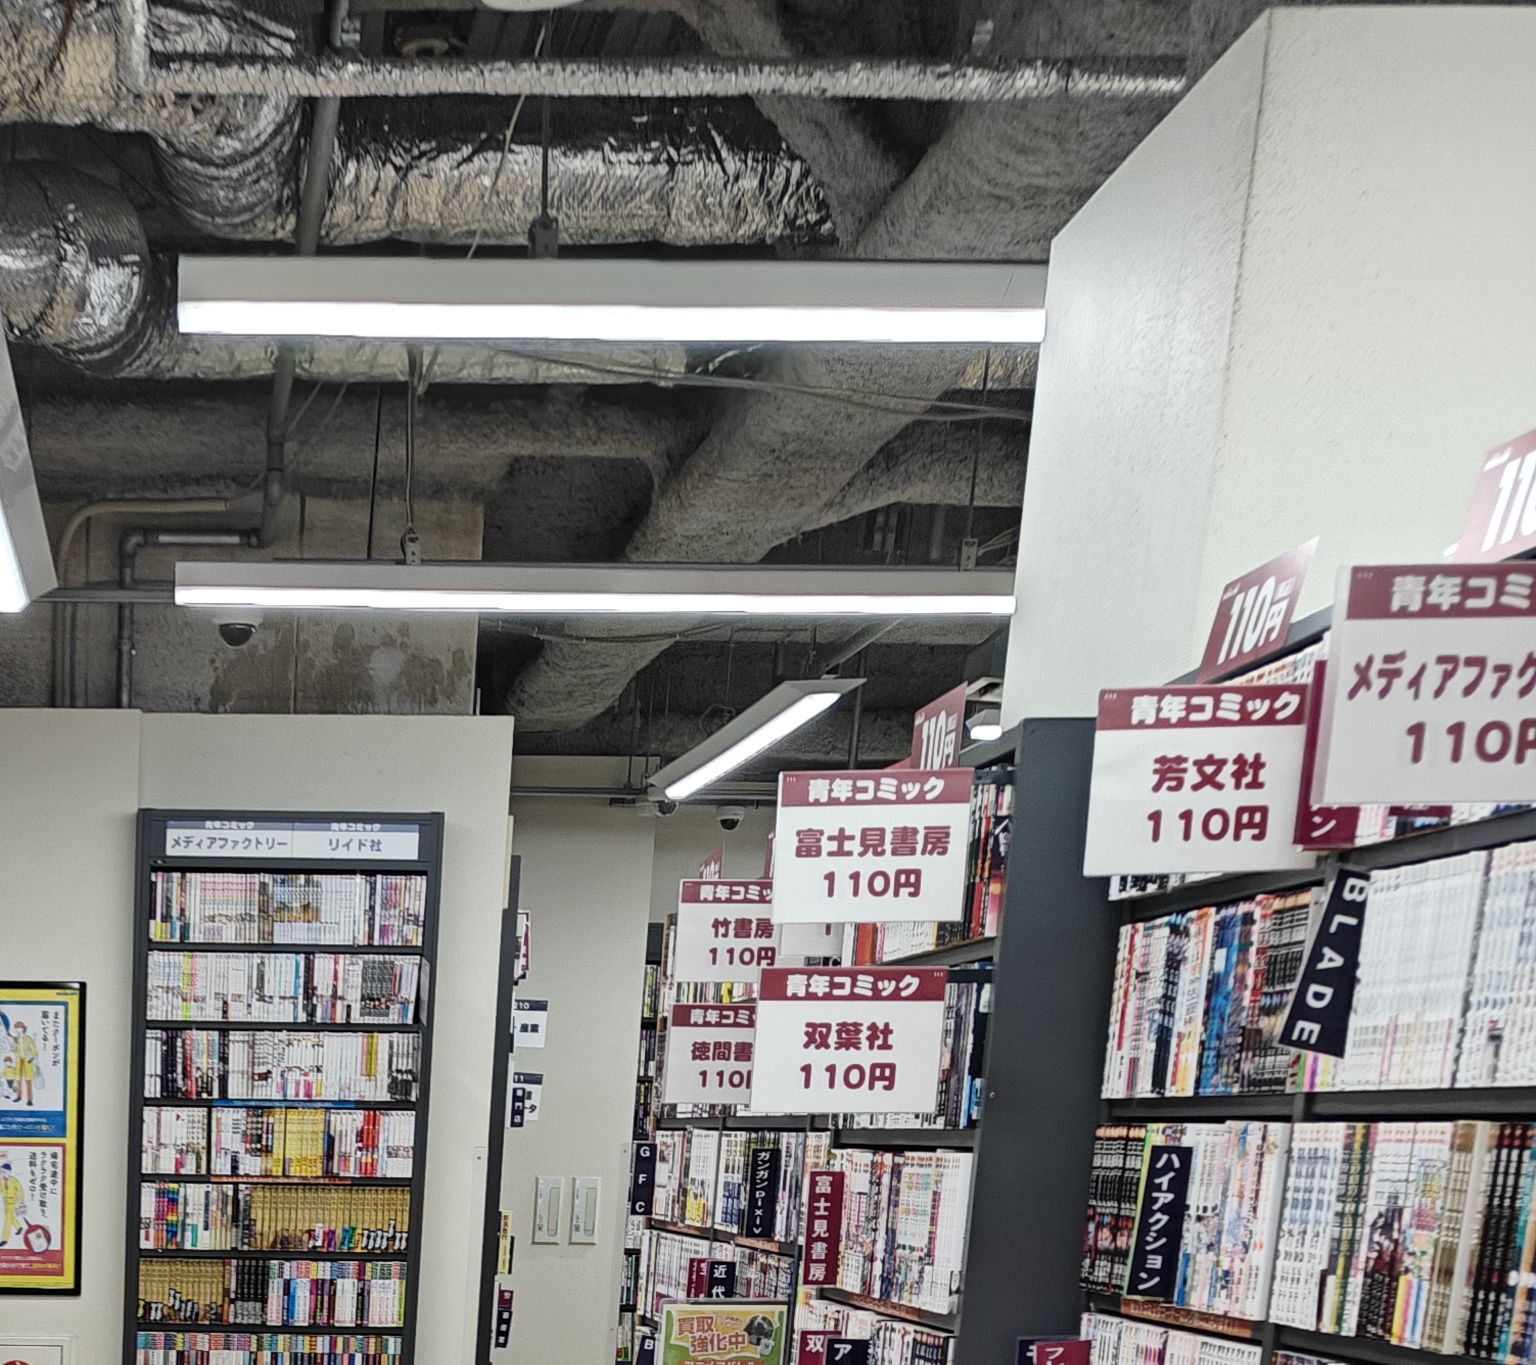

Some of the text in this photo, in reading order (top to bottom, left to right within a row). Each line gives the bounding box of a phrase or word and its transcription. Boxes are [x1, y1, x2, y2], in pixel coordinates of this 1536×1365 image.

[1130, 691, 1302, 726] 青年コミック
[1152, 753, 1266, 793] 芳文社
[808, 778, 945, 803] 青年コミック
[1147, 804, 1269, 843] 110円
[171, 836, 288, 850] メディアファクトリー
[328, 838, 382, 852] リイド社
[795, 826, 952, 858] 富士見書房
[823, 869, 922, 898] 110円
[711, 918, 774, 939] 竹書房
[709, 946, 776, 967] 110円
[1292, 877, 1371, 1045] BLADE
[786, 975, 921, 997] 青年コミック
[803, 1022, 894, 1052] 双葉社
[698, 1069, 752, 1089] 110
[799, 1063, 897, 1091] 110円
[808, 1175, 834, 1281] 富士見書房
[1137, 1151, 1180, 1289] ハイアクション
[677, 1315, 714, 1334] 買取
[690, 1331, 748, 1353] 強化中
